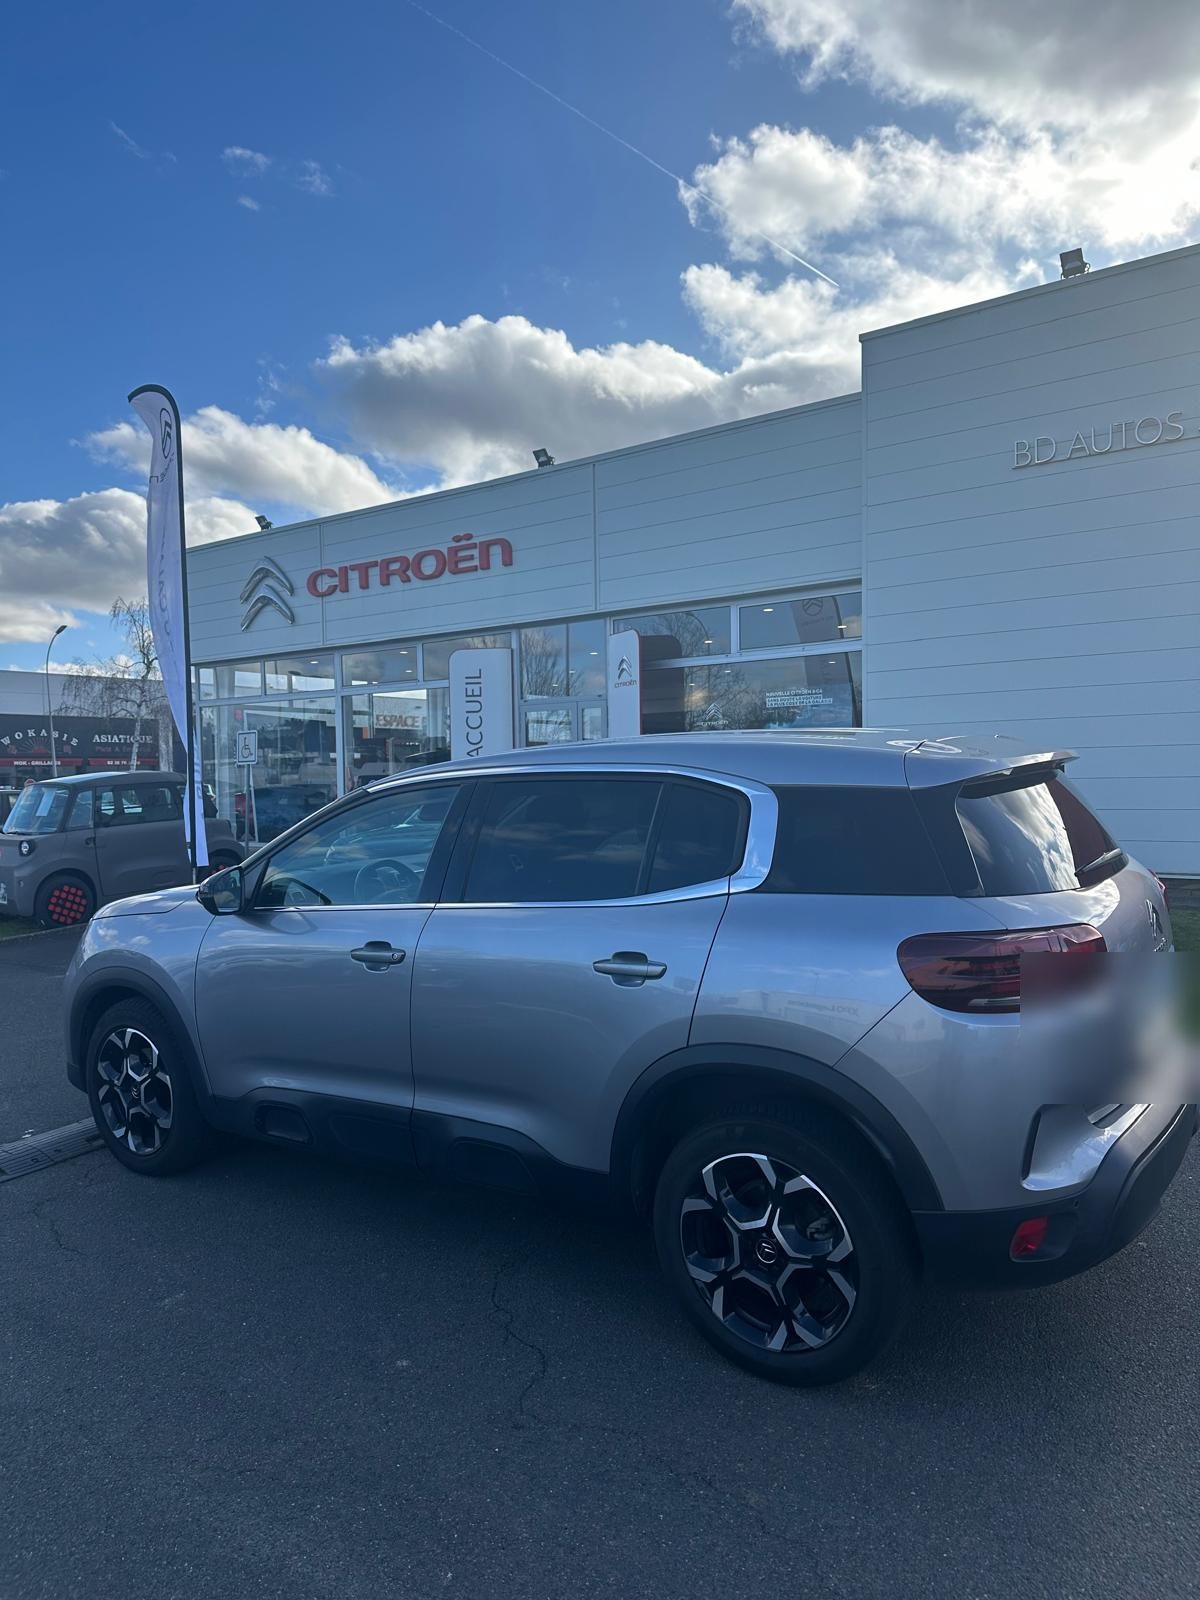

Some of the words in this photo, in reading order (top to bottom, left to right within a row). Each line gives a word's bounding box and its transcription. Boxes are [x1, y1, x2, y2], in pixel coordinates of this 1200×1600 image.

[1013, 436, 1056, 468] BD
[1066, 410, 1185, 460] AUTOS
[306, 533, 513, 597] CITROËN
[92, 734, 153, 744] ASIATIQUE
[465, 668, 483, 757] ACCUEIL
